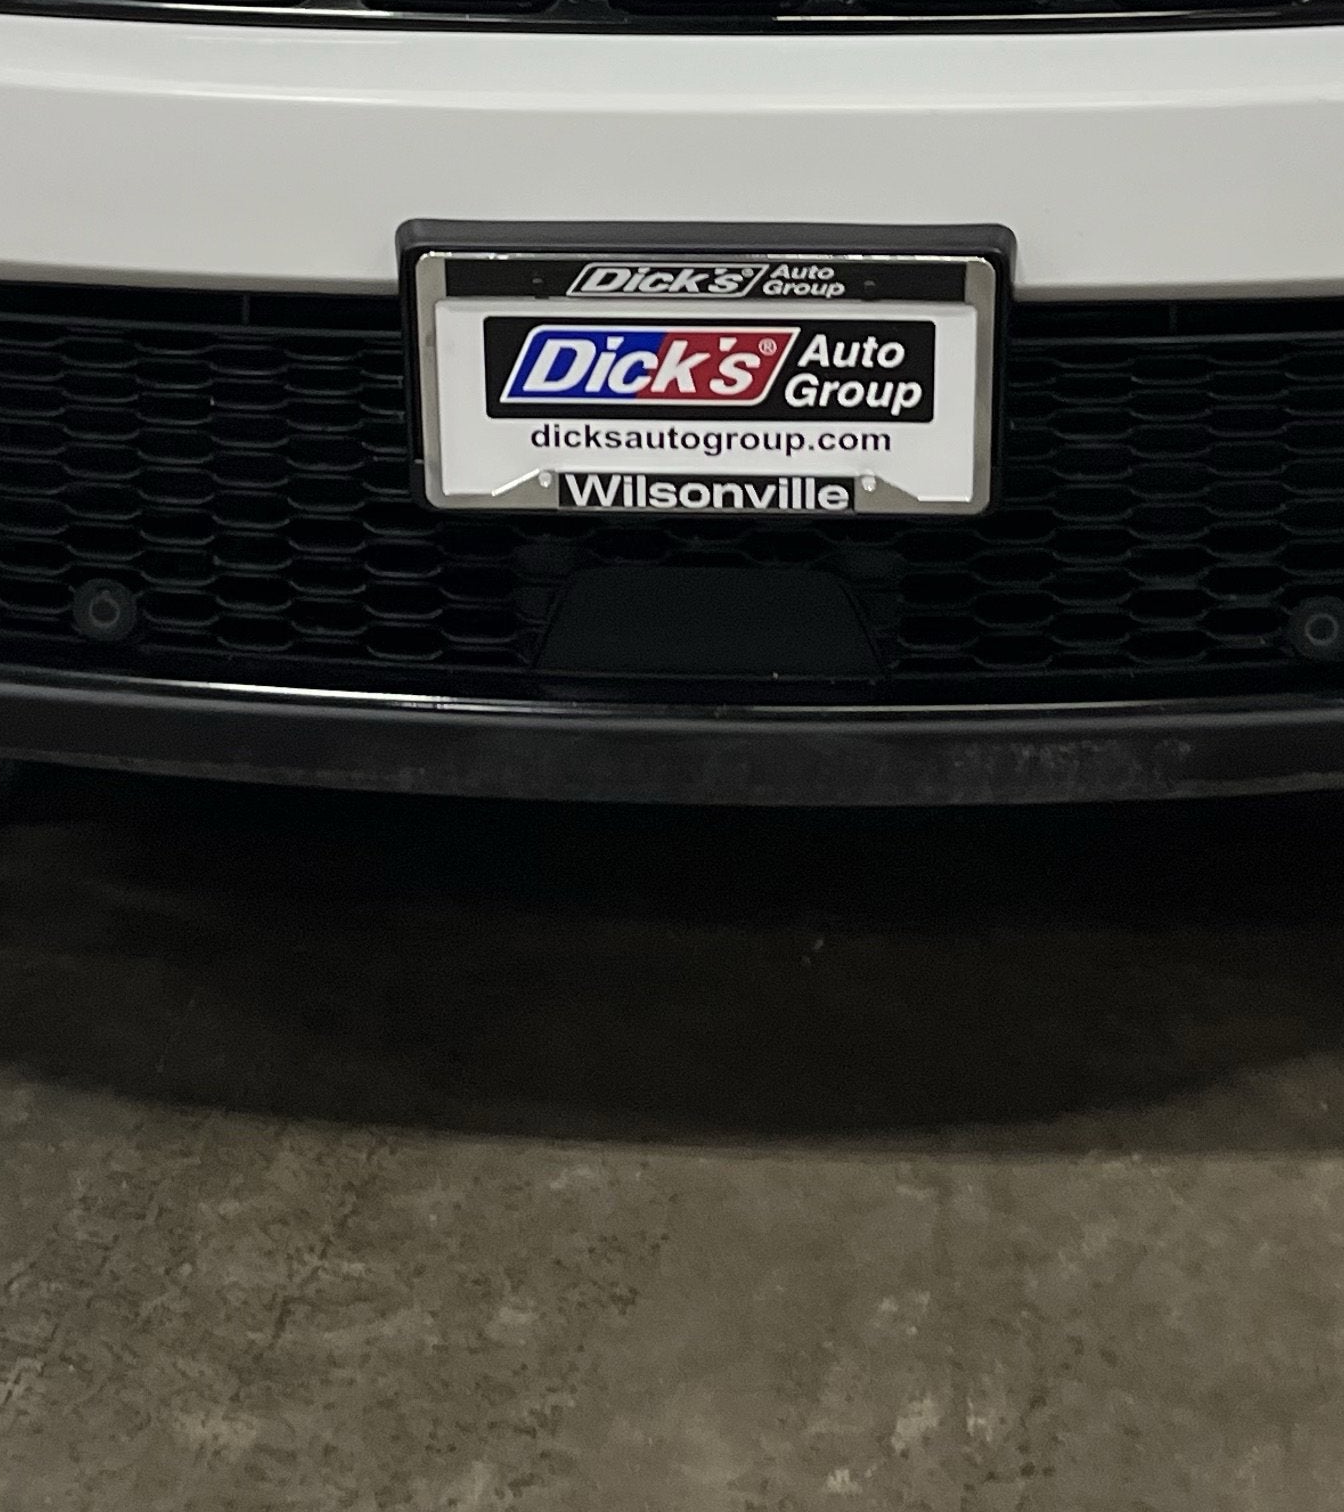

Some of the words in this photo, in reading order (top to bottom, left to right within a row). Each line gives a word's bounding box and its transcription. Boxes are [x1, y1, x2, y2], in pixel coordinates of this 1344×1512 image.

[762, 279, 846, 298] Group
[769, 264, 835, 280] Auto
[797, 334, 905, 369] Auto
[784, 374, 922, 415] Group
[530, 424, 891, 456] dicksautogroup.com
[565, 473, 850, 510] Wilsonville
